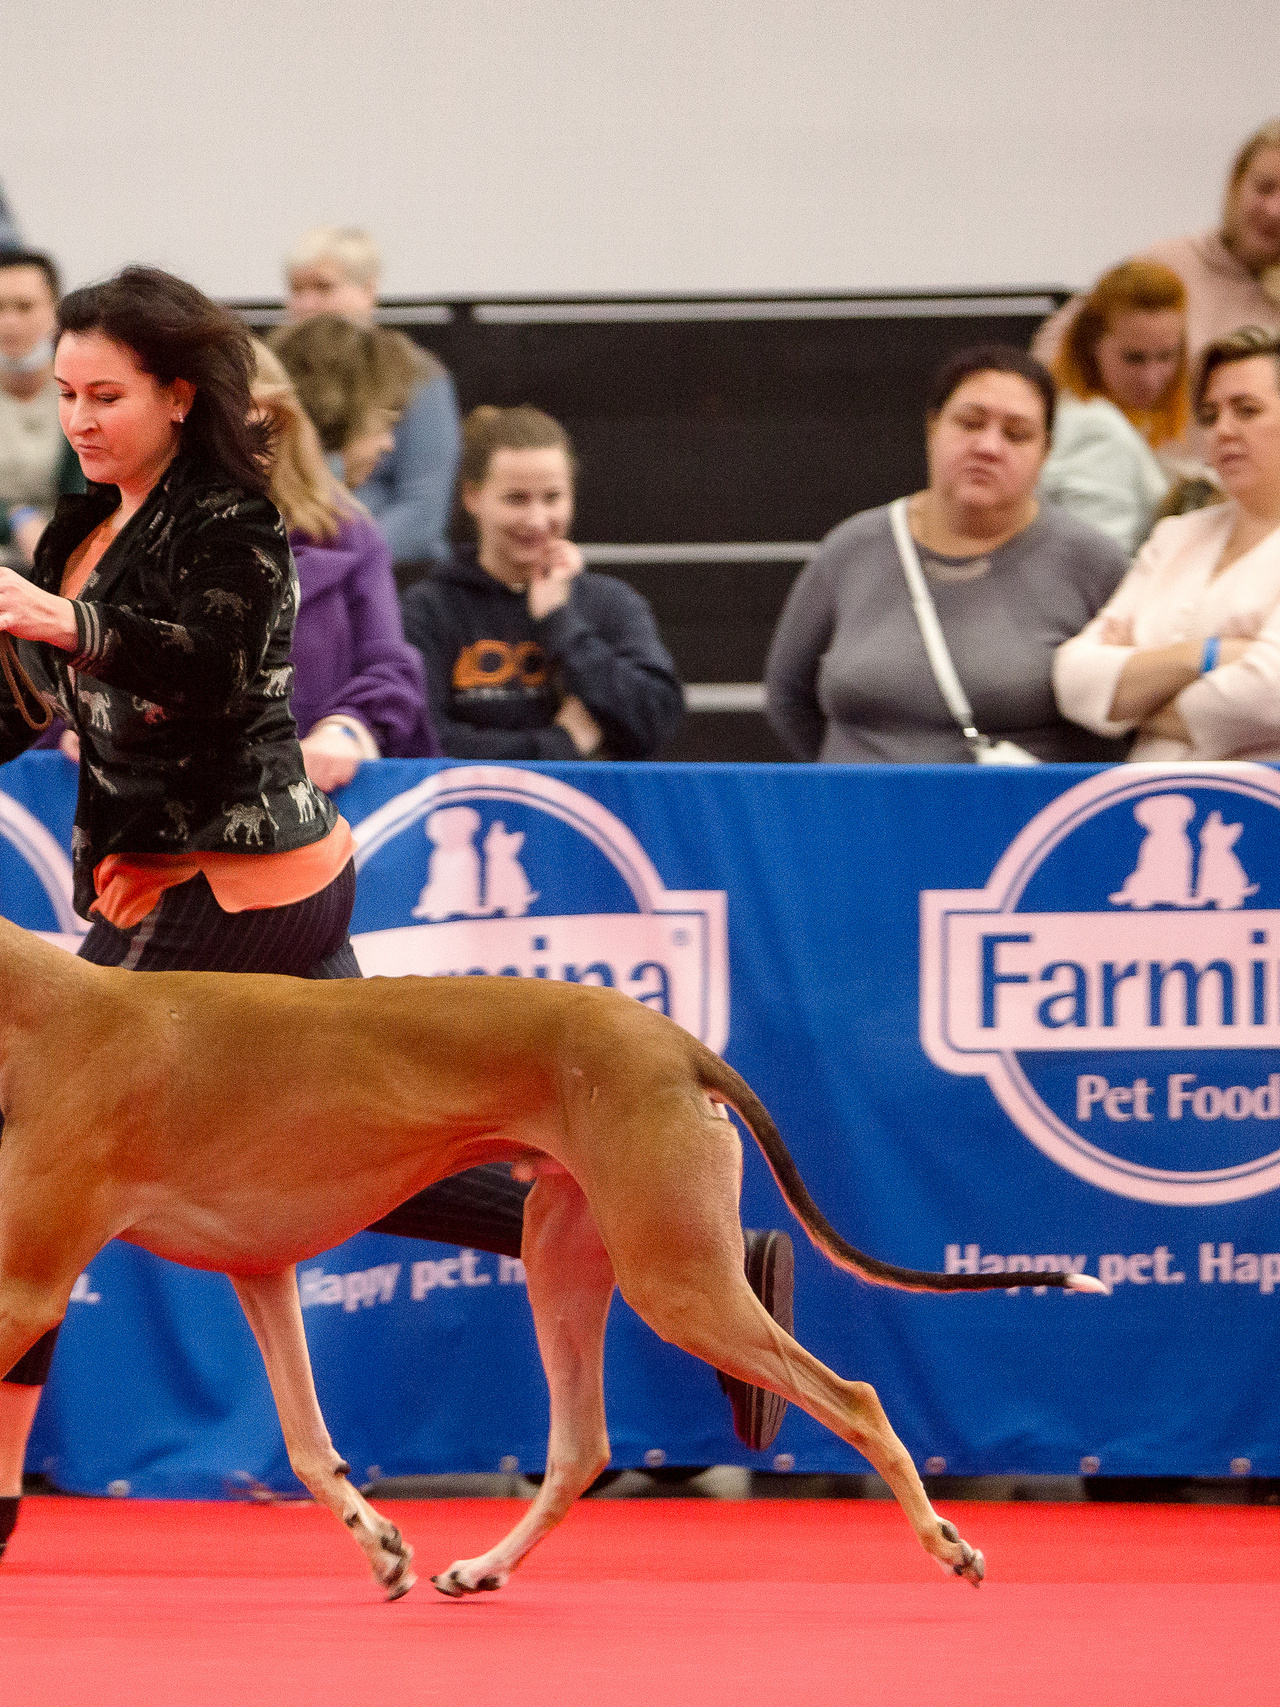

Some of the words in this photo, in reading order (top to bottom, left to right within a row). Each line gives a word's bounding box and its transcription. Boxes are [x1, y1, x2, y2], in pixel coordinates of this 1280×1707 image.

[979, 930, 1280, 1029] Farmi
[1077, 1075, 1153, 1121] Pet
[1167, 1074, 1280, 1121] Food
[1099, 1246, 1186, 1296] pet.
[1198, 1242, 1280, 1295] Hap
